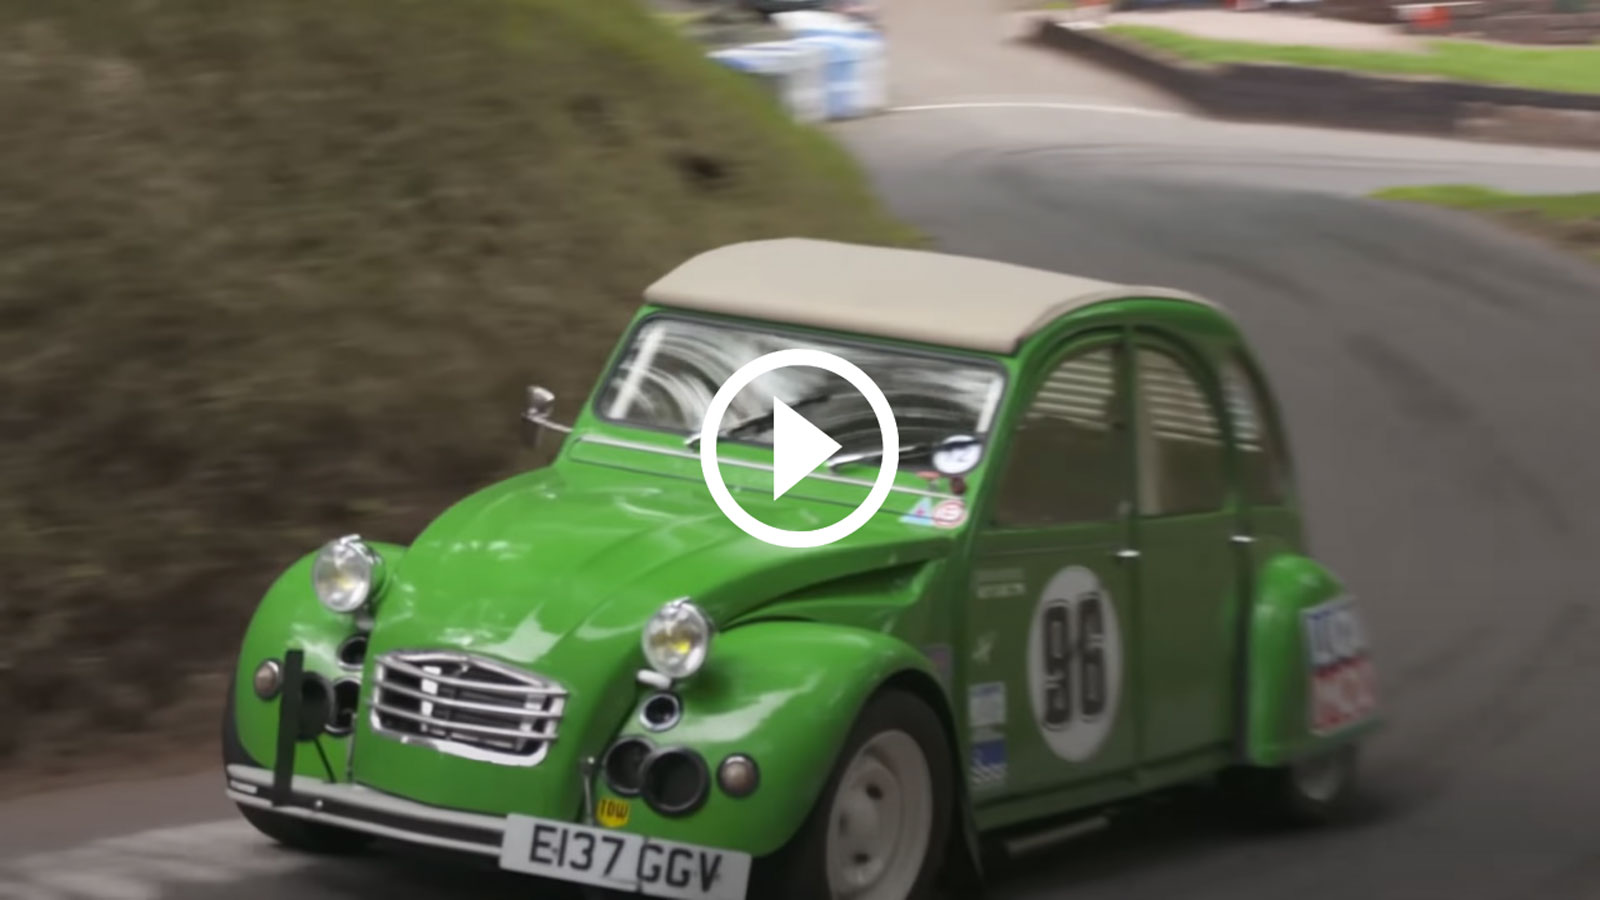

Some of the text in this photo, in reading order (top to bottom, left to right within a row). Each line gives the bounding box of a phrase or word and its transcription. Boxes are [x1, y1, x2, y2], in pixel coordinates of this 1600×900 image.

[1042, 594, 1107, 731] 96
[529, 823, 722, 893] E137 GGV
